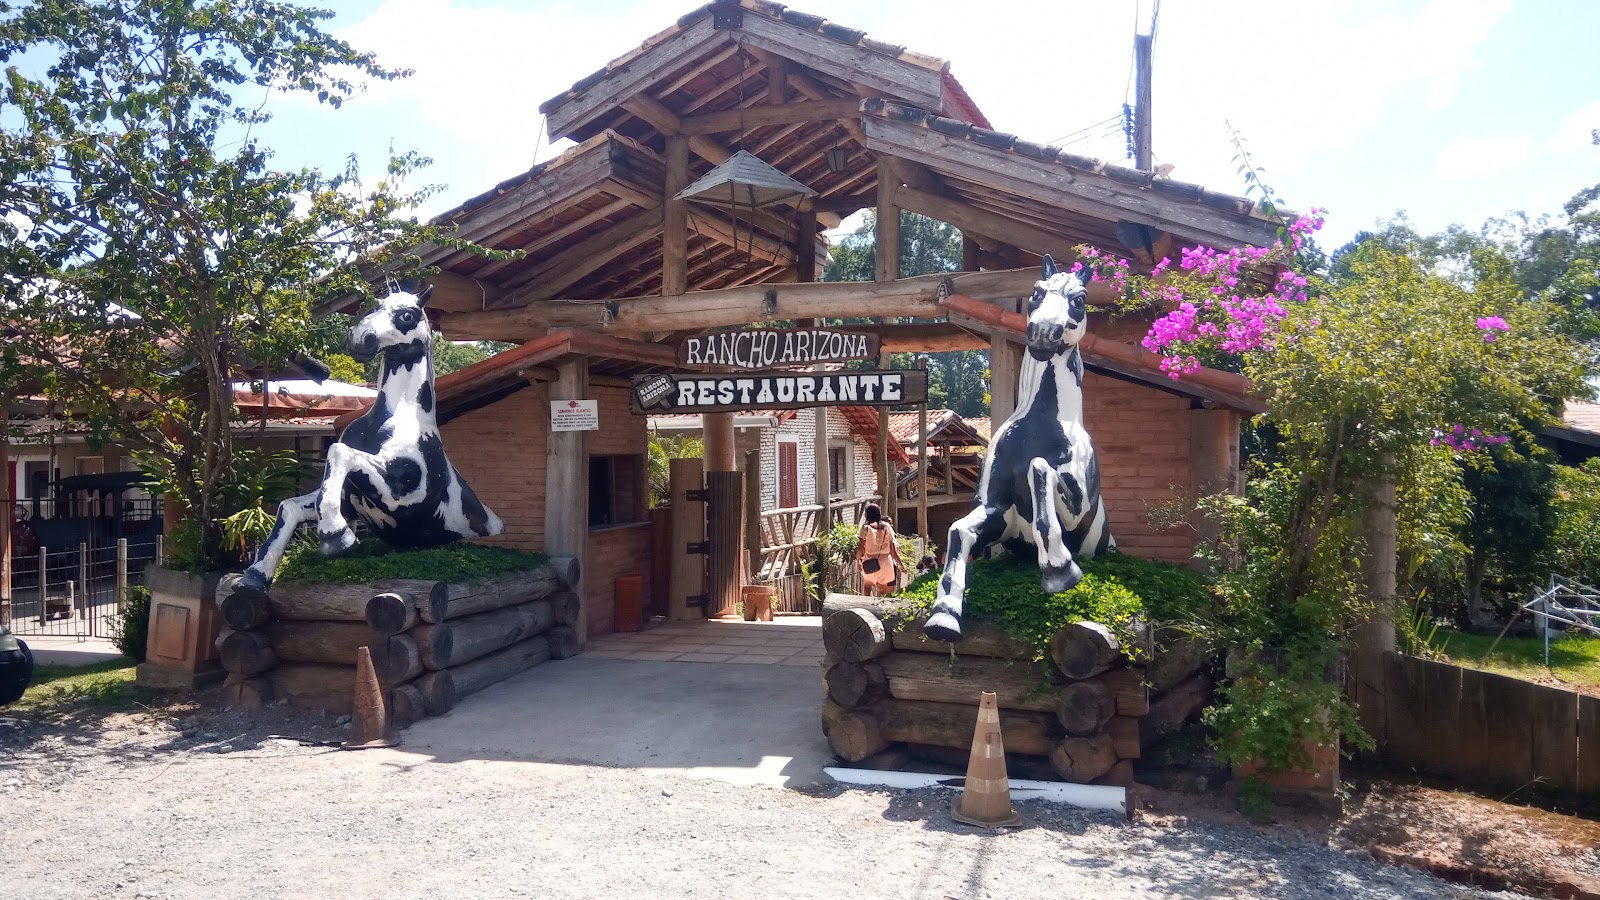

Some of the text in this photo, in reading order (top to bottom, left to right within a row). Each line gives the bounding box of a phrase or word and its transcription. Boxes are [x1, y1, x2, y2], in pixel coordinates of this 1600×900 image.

[780, 330, 868, 363] ARIZONA
[639, 377, 667, 396] RANCHO
[642, 383, 671, 403] ARIZONA
[677, 374, 901, 406] RESTAURANTE
